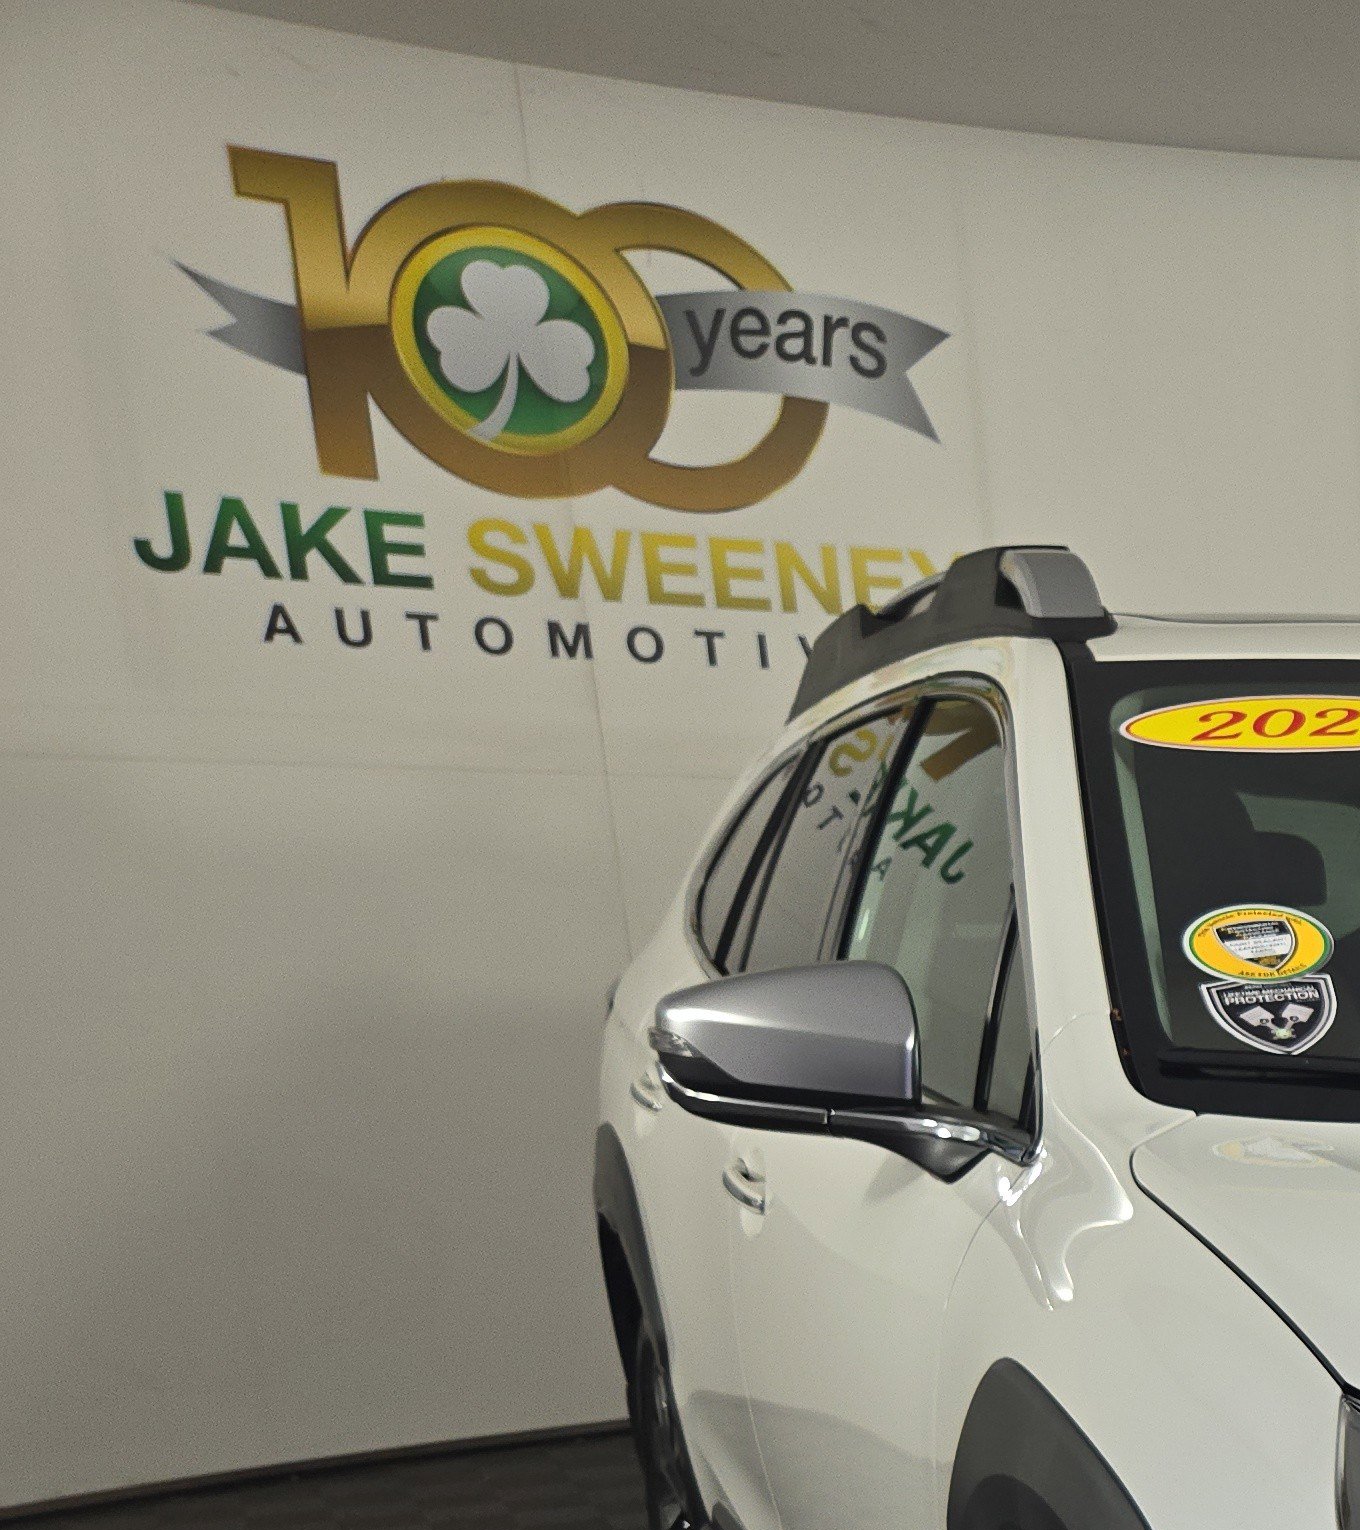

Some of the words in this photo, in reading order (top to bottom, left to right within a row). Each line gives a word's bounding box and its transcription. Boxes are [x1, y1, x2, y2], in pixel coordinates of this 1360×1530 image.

[226, 144, 830, 514] 100
[683, 304, 890, 379] years
[133, 489, 434, 590] JAKE
[262, 603, 814, 669] AUTOMOTI
[1223, 990, 1320, 1006] PROTECTION
